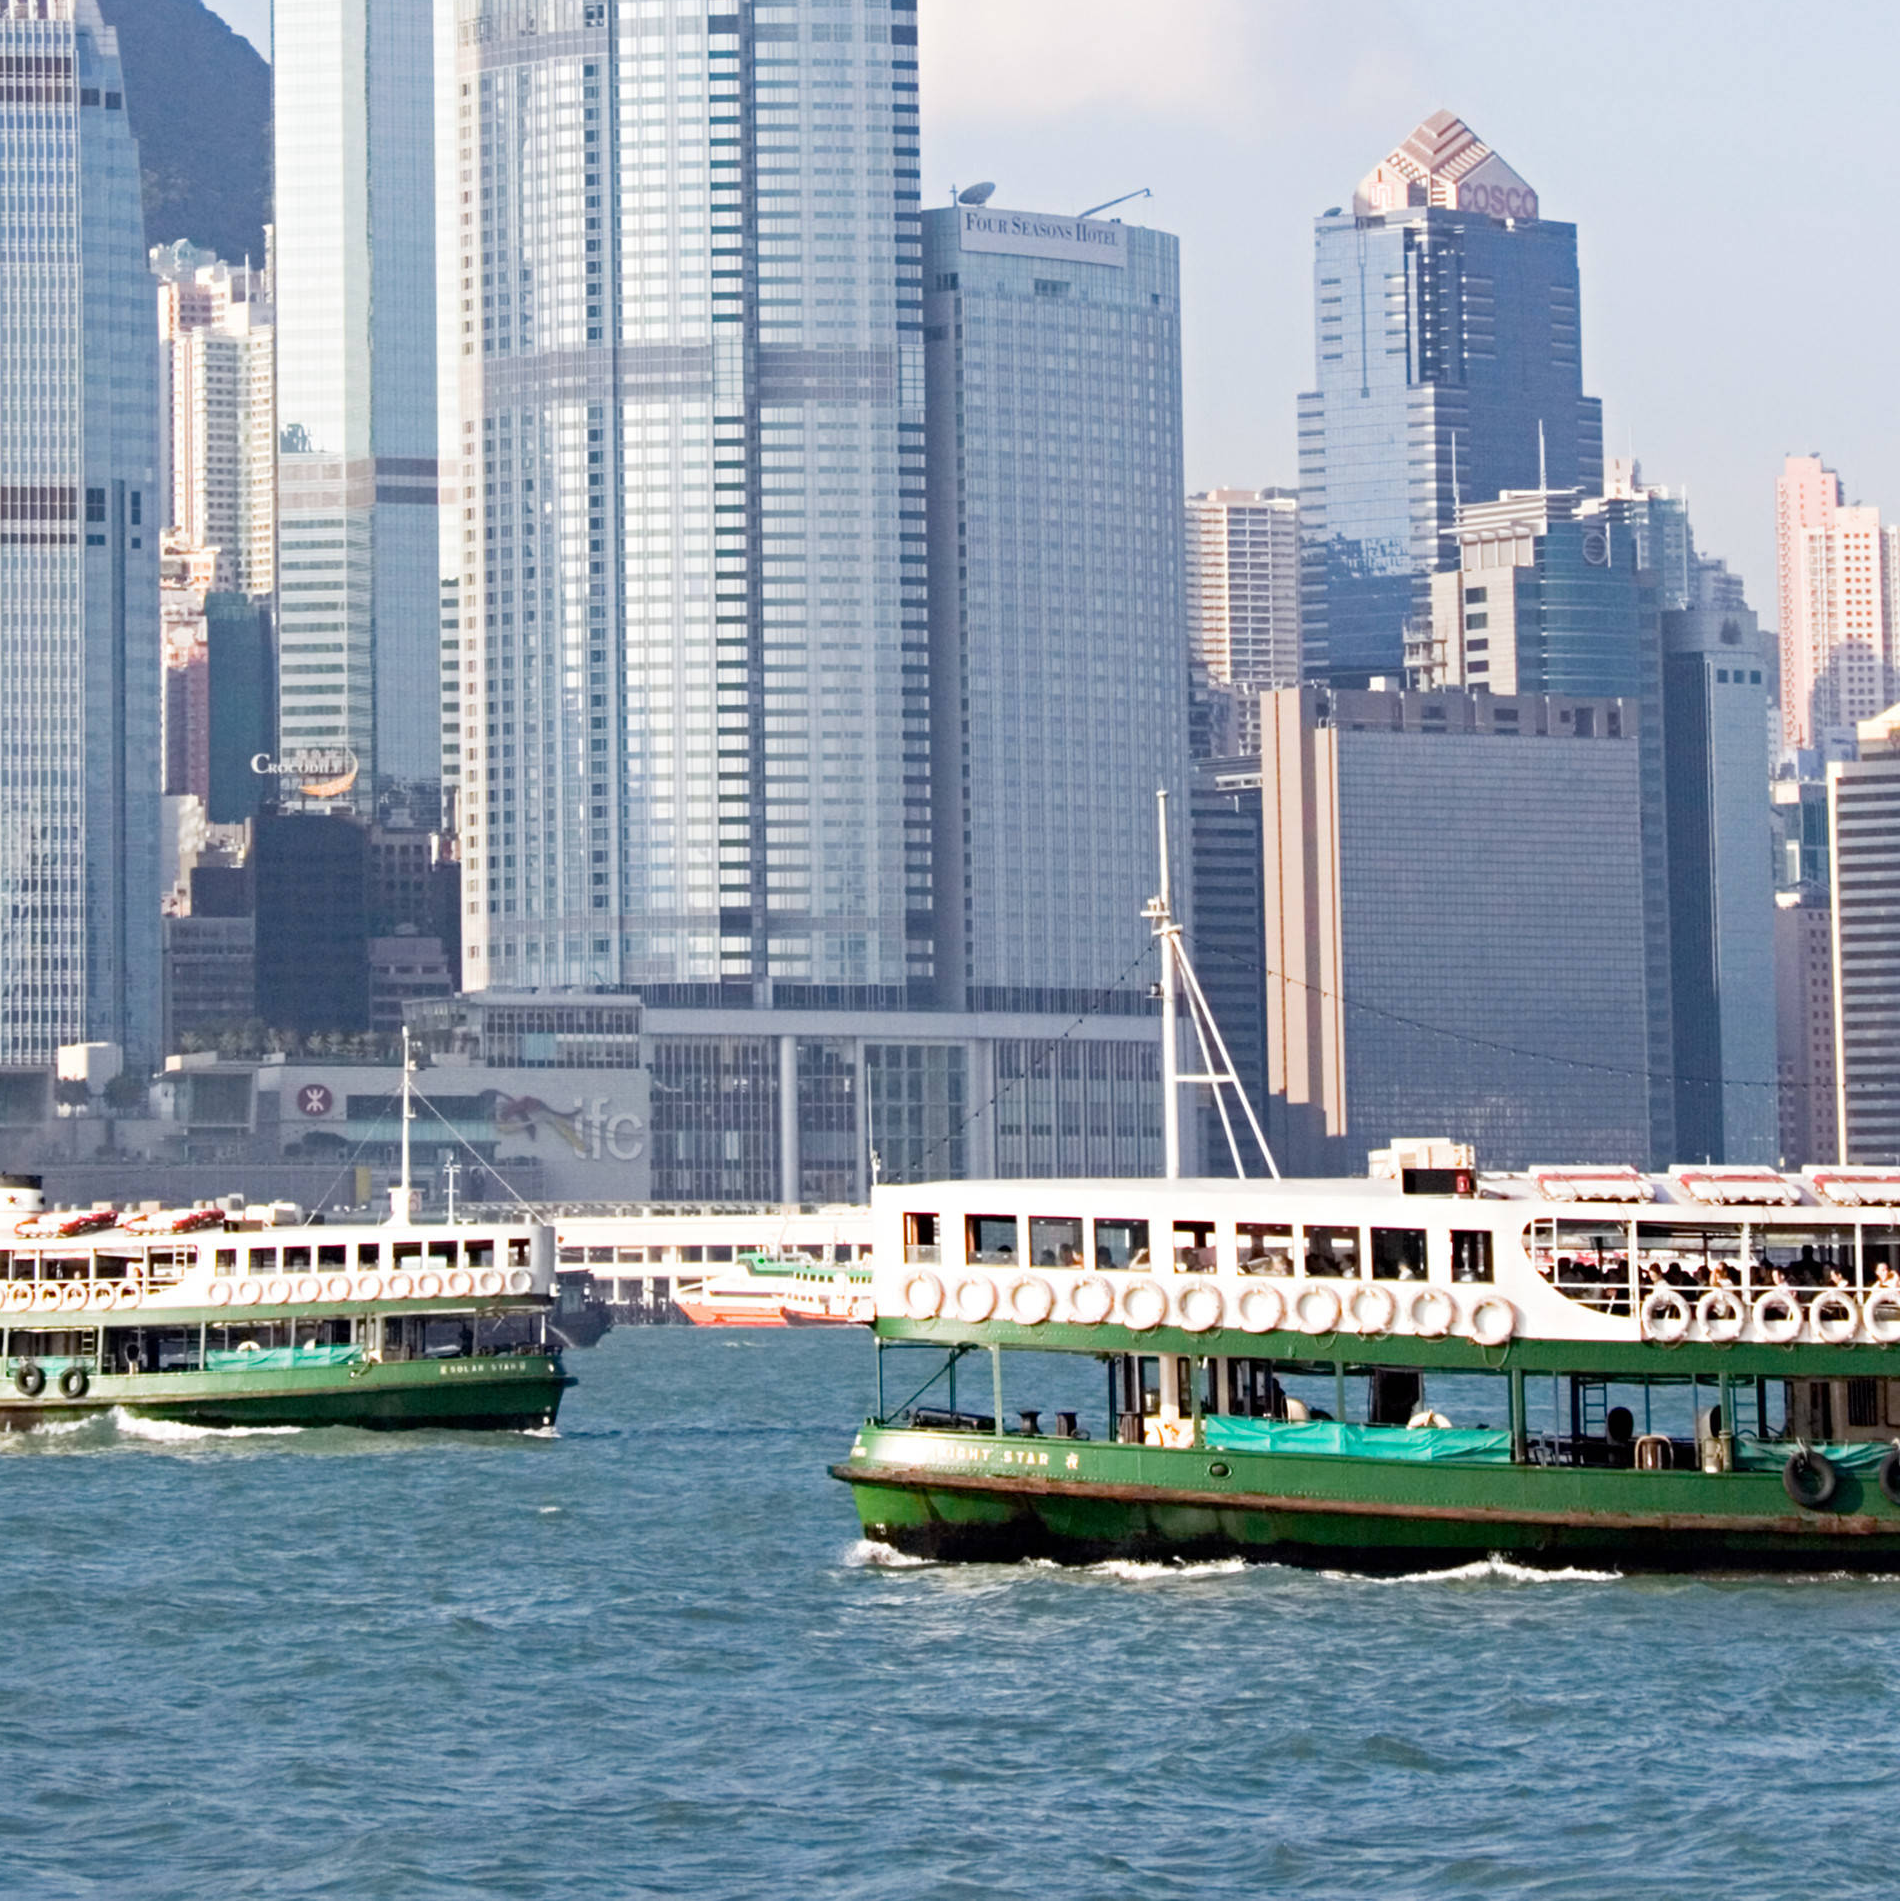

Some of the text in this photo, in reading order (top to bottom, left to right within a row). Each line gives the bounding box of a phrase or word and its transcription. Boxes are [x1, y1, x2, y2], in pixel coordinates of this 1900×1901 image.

[1458, 183, 1536, 216] COSCO
[966, 212, 1118, 246] FOUR SEASONS HOTEL
[574, 1098, 643, 1161] ifc
[1003, 1450, 1049, 1466] STAR
